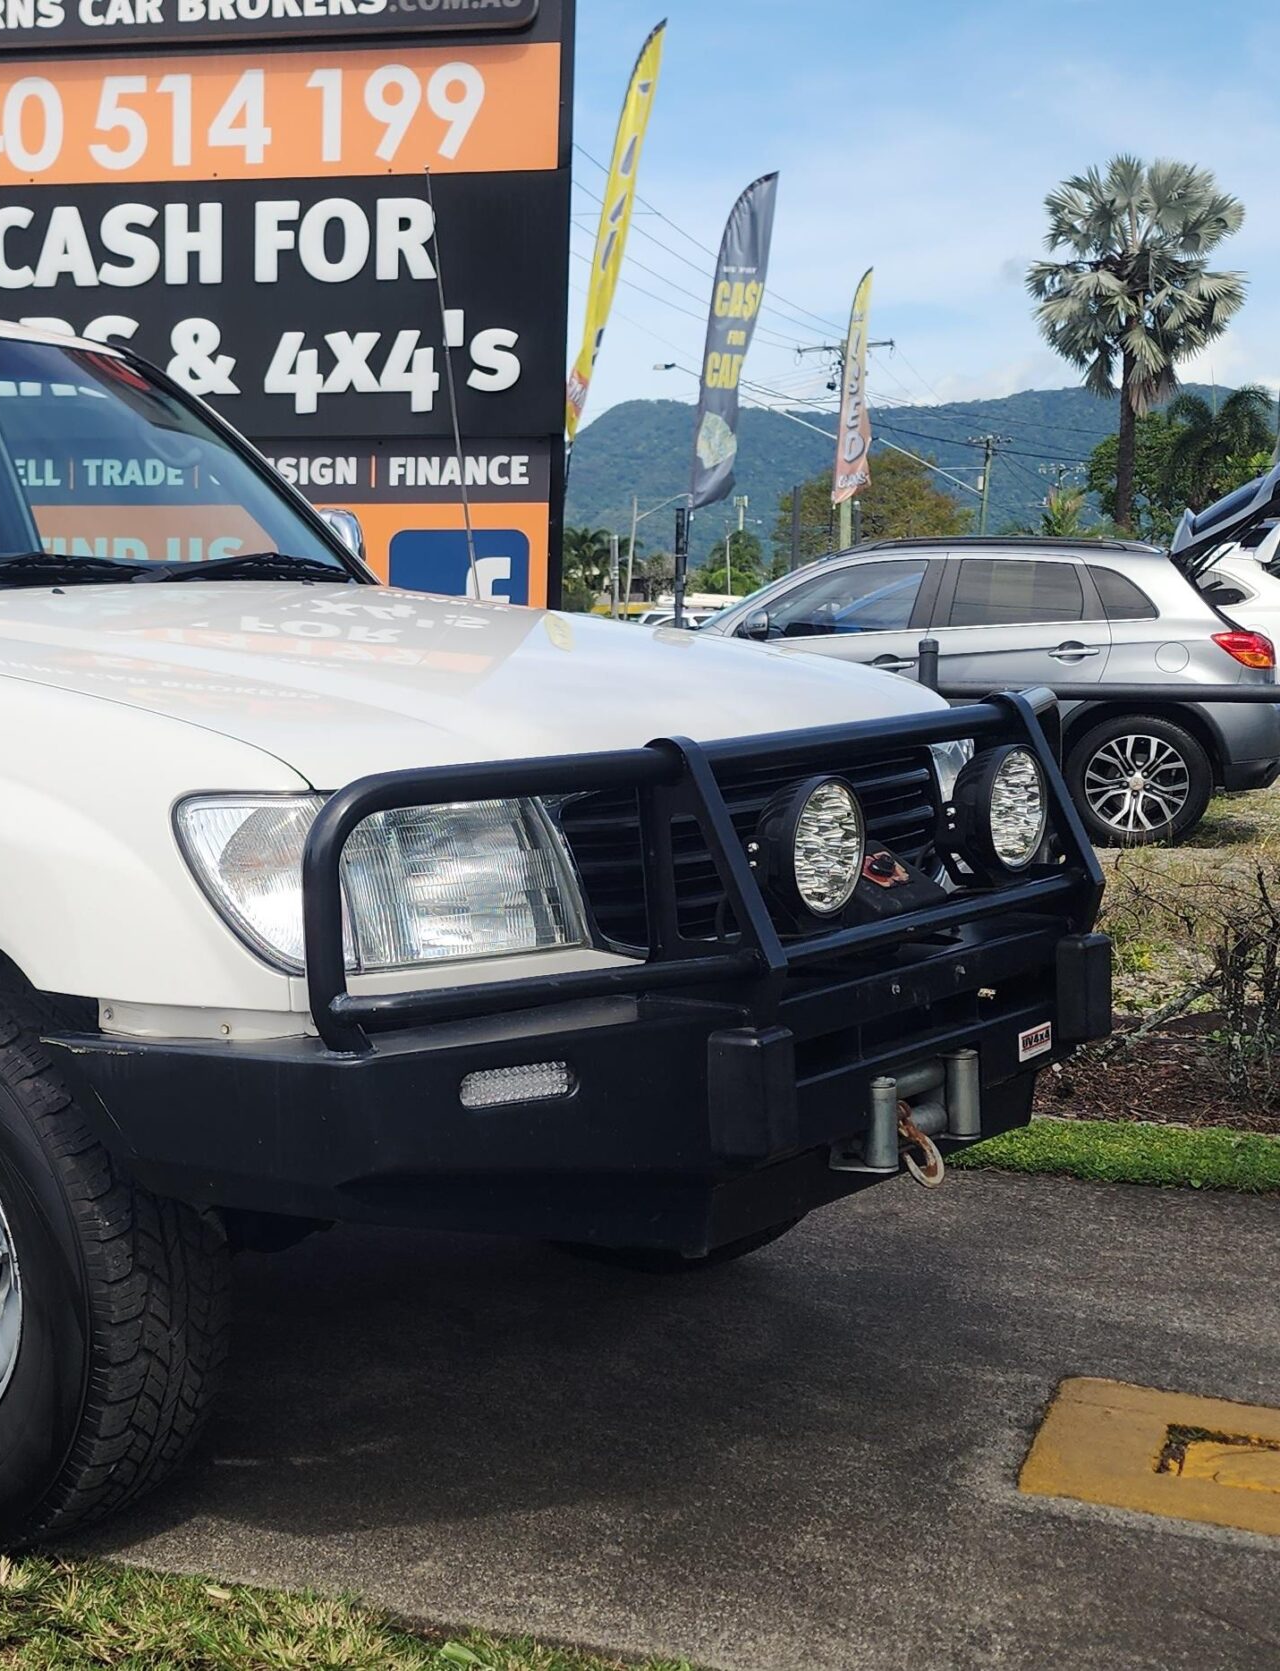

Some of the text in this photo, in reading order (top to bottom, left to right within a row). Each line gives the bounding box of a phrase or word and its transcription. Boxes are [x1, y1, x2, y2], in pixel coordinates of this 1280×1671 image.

[78, 0, 164, 27] CAR
[89, 69, 272, 170] 514
[307, 61, 485, 163] 199
[254, 197, 438, 283] FOR
[166, 316, 242, 395] &
[13, 458, 61, 487] ELL
[83, 458, 184, 486] TRADE
[266, 456, 358, 486] SIGN
[389, 455, 529, 486] FINANCE
